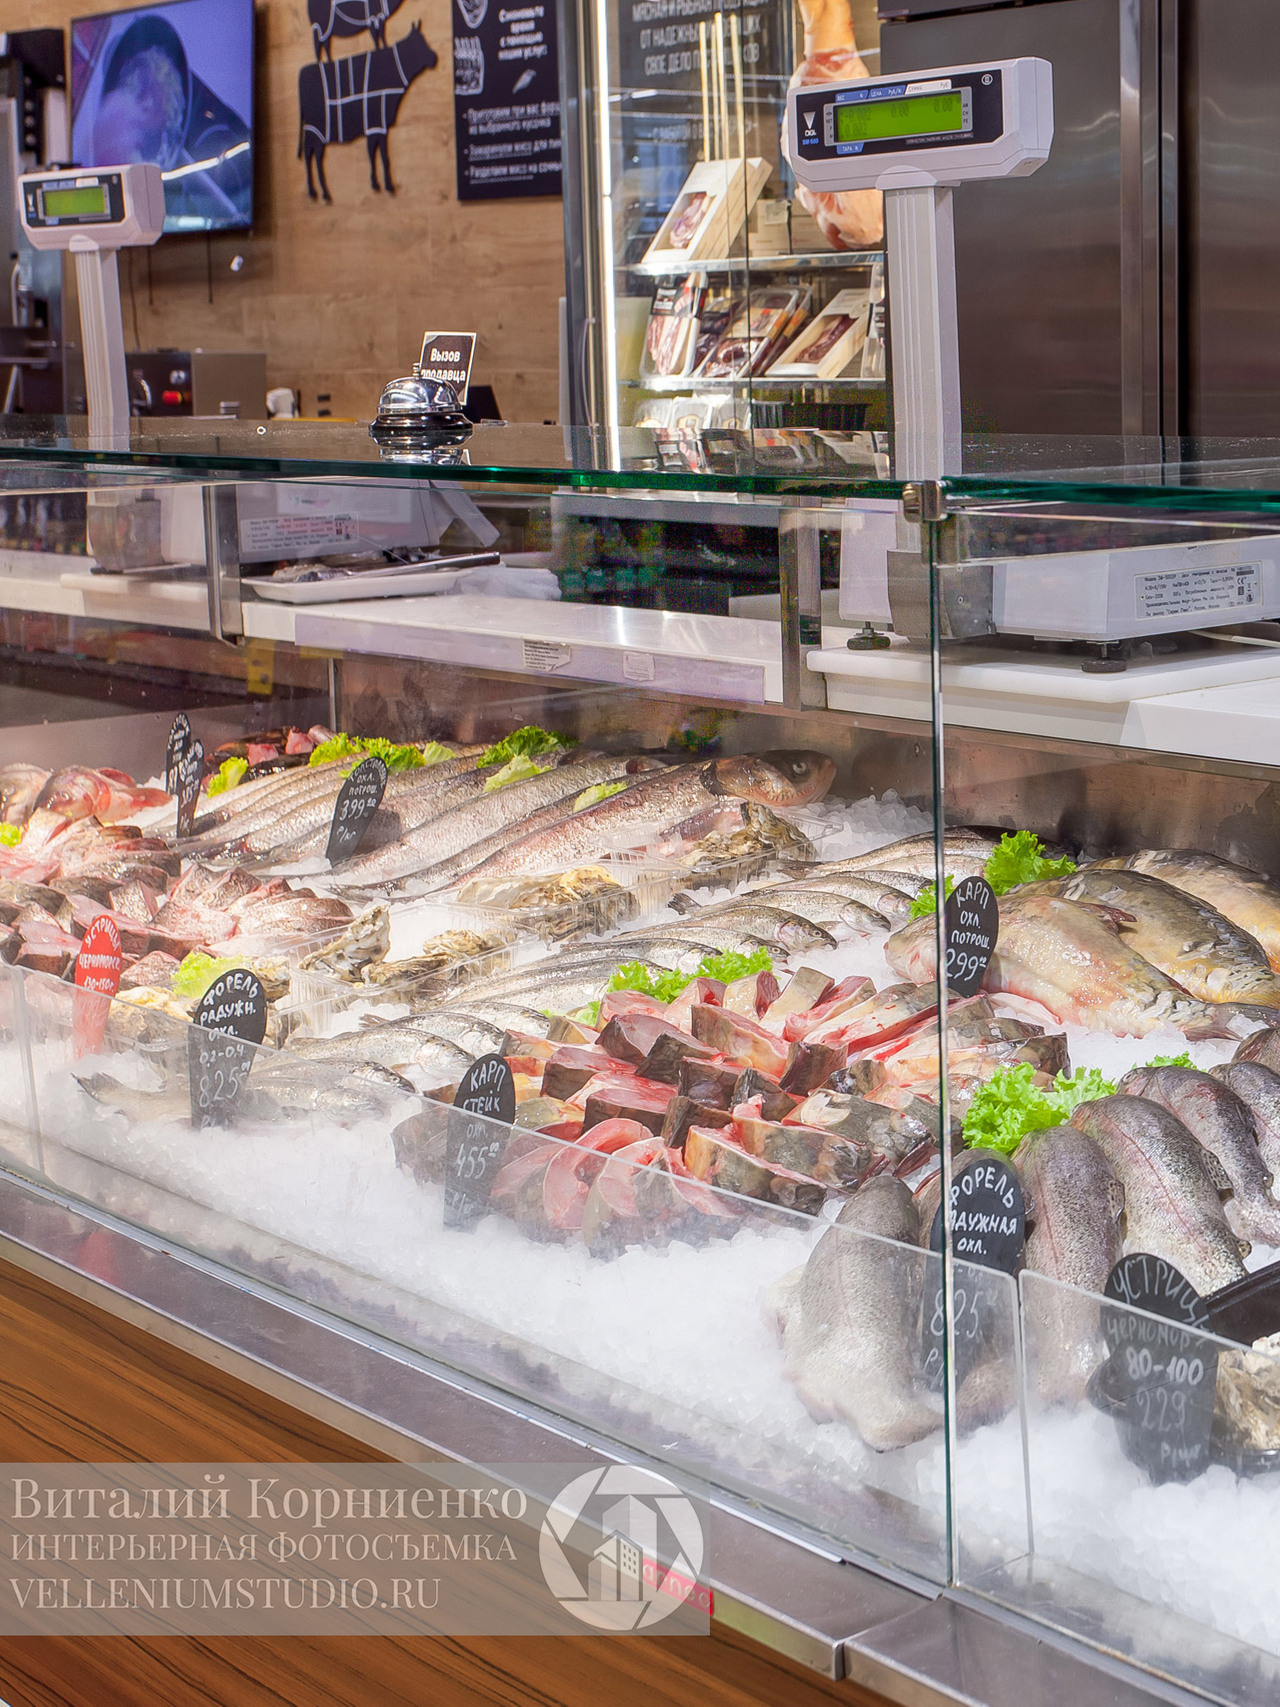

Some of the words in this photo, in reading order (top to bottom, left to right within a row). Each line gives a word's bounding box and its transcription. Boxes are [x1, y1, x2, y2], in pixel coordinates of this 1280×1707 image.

[430, 347, 461, 362] Вызов
[955, 881, 989, 909] КАРП
[85, 918, 120, 951] УСТРИЦЫ
[203, 973, 259, 1006] ФОРЕЛЬ
[470, 1060, 506, 1092] КАРП
[463, 1089, 500, 1115] СТЕЙК
[950, 1210, 1018, 1236] АДУЖНАЯ
[1125, 1346, 1204, 1386] 80-100
